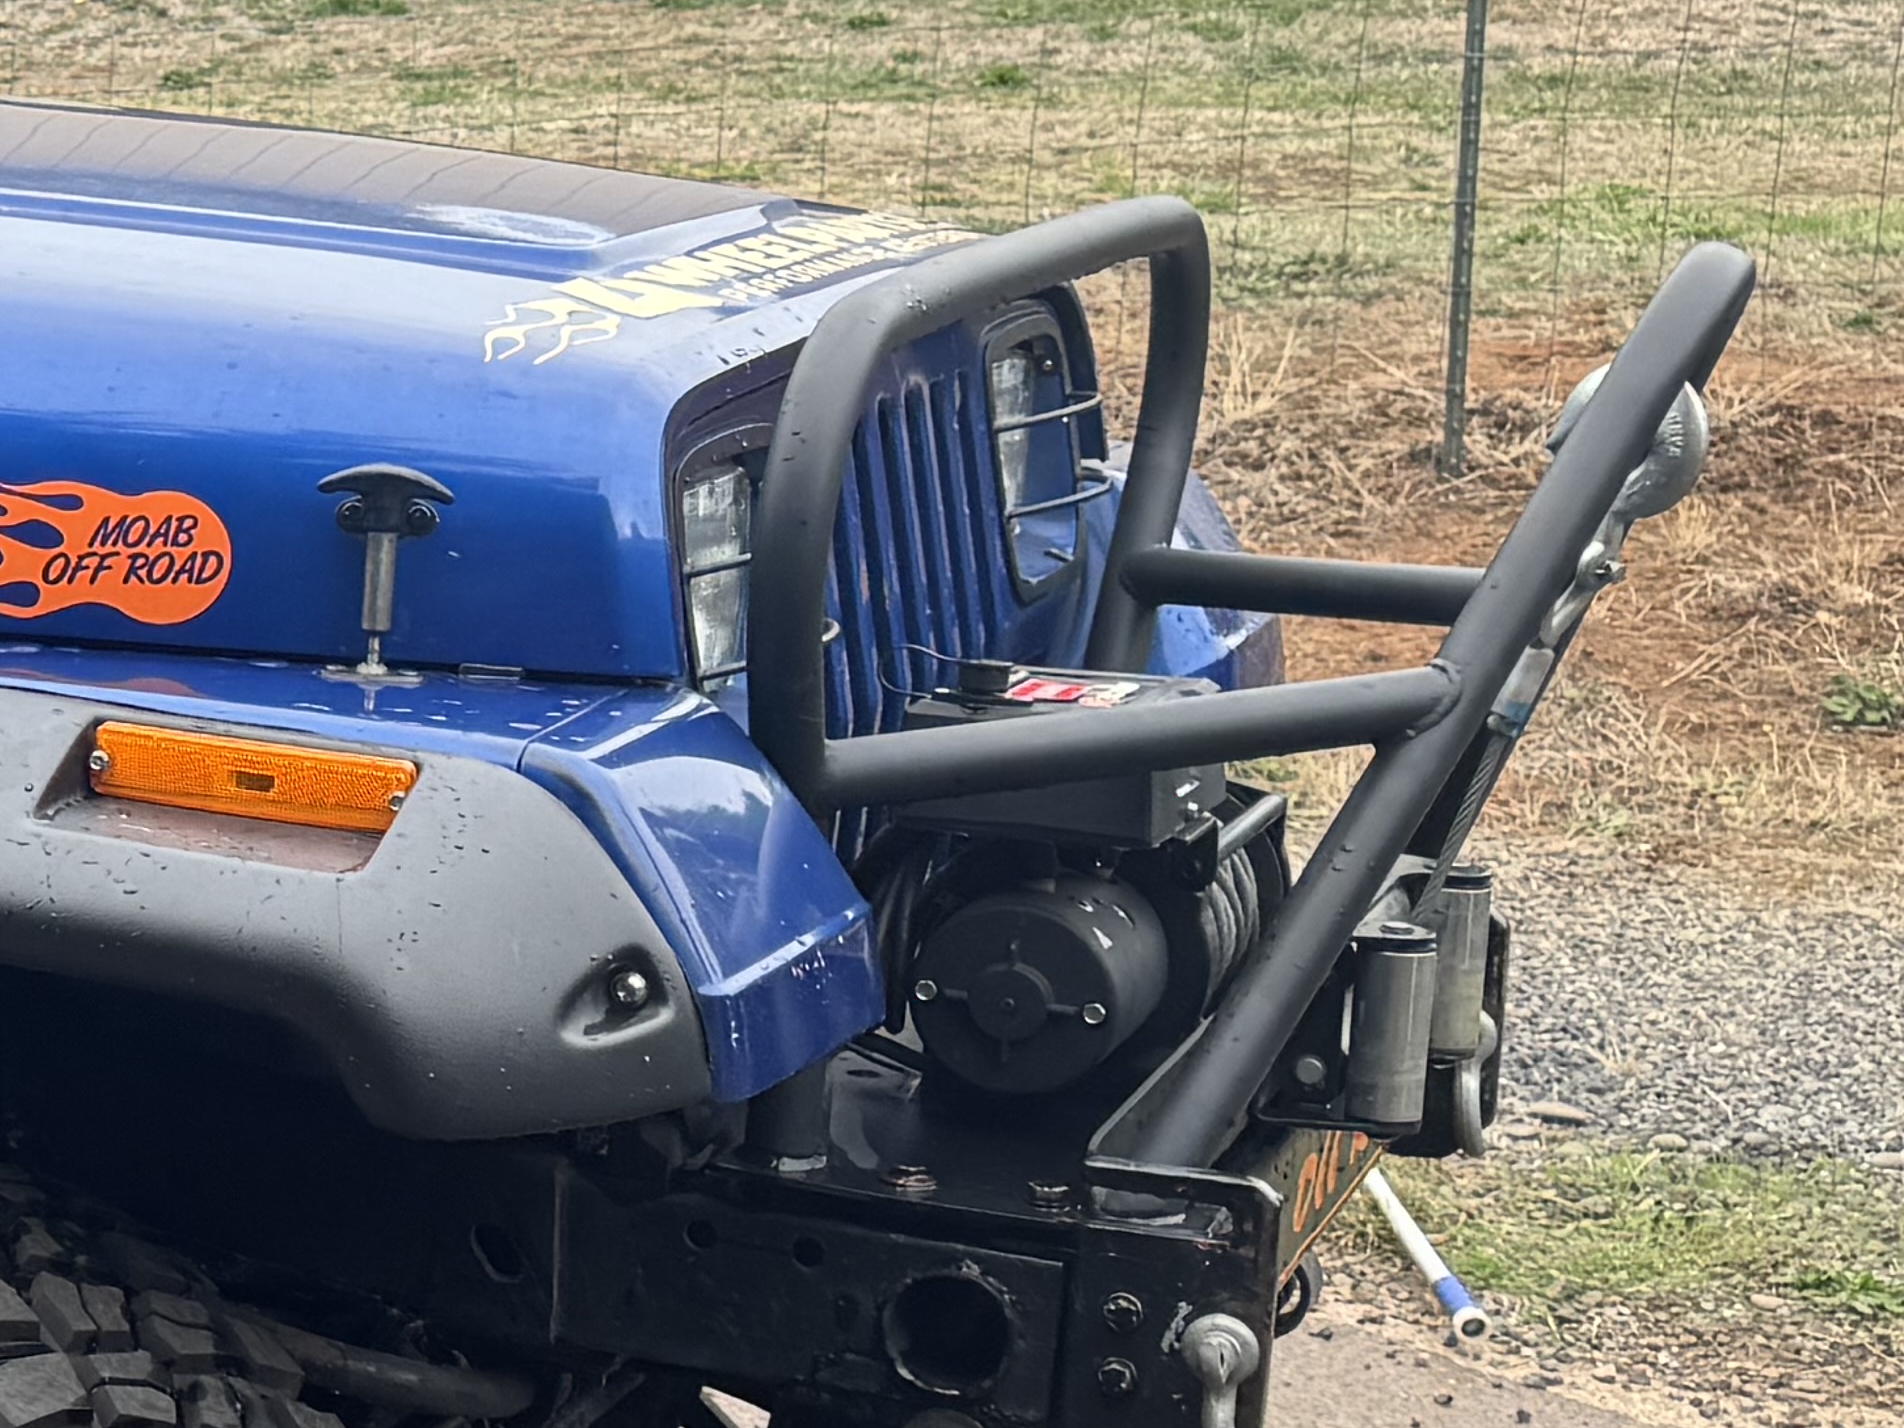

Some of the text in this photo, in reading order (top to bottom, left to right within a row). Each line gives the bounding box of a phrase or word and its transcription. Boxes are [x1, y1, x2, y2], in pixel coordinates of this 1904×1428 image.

[88, 515, 197, 549] MOAB
[41, 550, 224, 586] OFF ROAD
